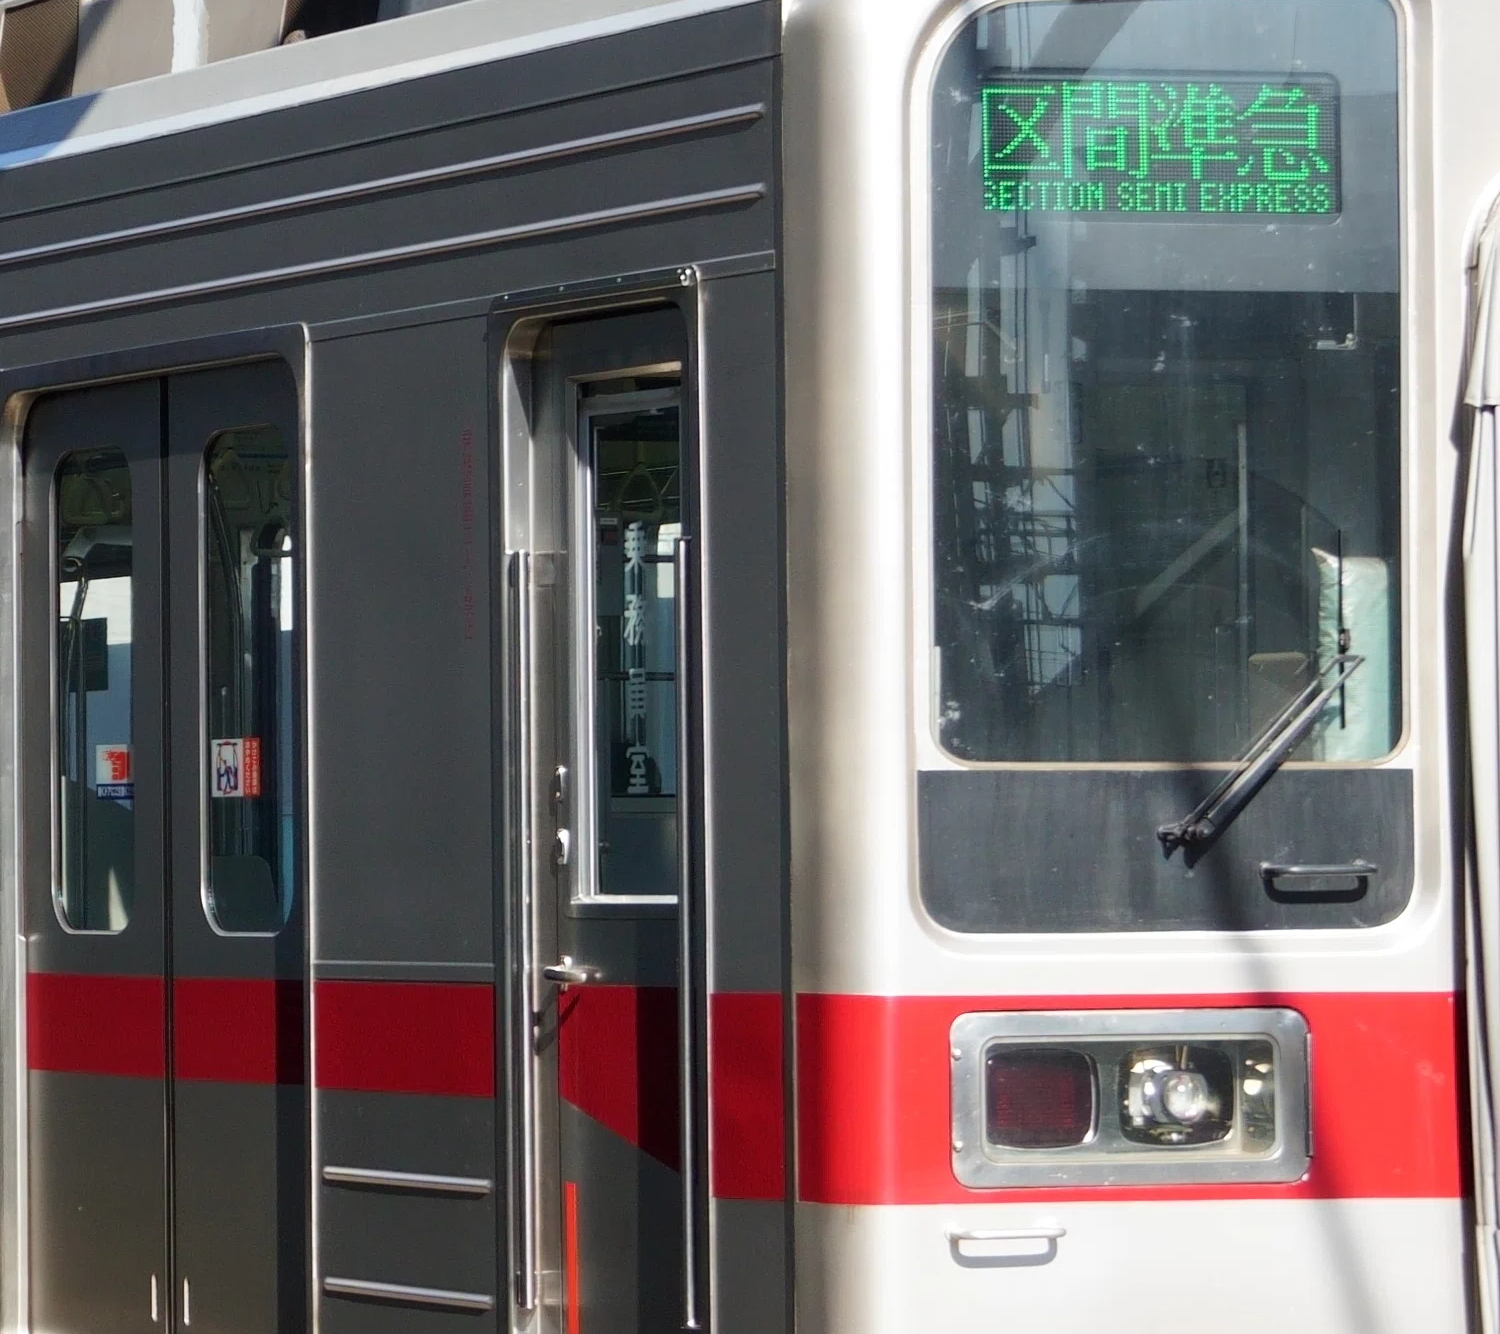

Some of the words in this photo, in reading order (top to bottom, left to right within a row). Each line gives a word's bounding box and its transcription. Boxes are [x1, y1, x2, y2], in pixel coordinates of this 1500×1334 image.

[981, 81, 1331, 181] 区間準急
[983, 180, 1104, 212] SECTION
[1116, 182, 1187, 212] SEMI
[1200, 182, 1331, 213] EXPRESS
[623, 520, 651, 795] 乗務員室
